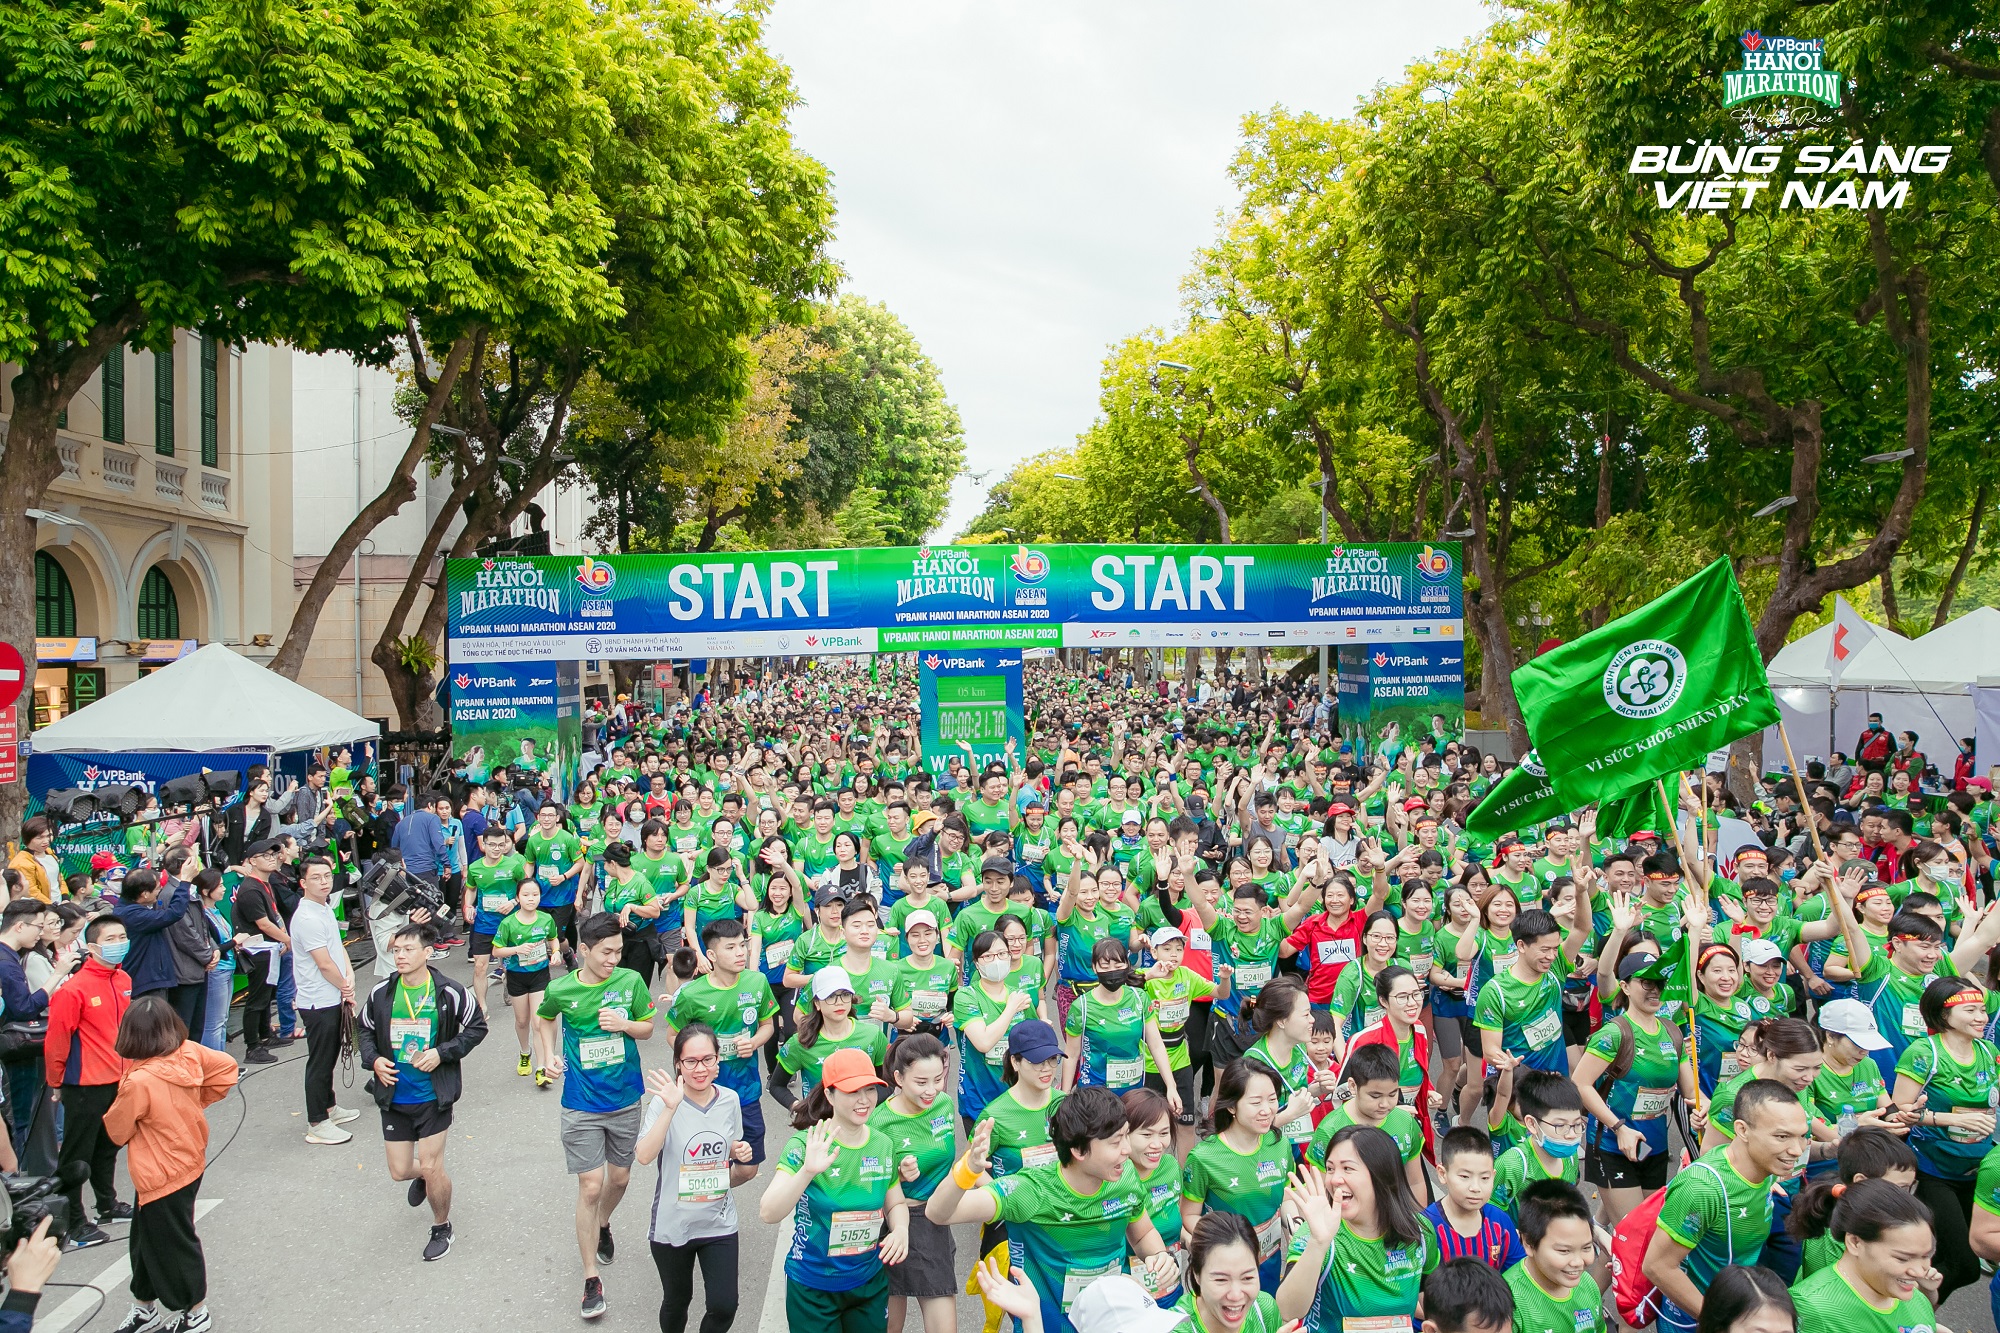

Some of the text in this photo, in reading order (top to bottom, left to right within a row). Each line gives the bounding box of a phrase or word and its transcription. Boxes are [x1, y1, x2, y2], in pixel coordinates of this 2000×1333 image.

[934, 549, 970, 559] VPBank
[1346, 549, 1379, 557] VPBank
[499, 561, 534, 570] VPBank
[912, 558, 979, 576] HANOI
[1326, 557, 1388, 574] HANOI
[476, 570, 544, 588] HANOI
[1091, 555, 1254, 612] START
[668, 561, 838, 621] START
[896, 576, 995, 607] MARATHON
[1015, 588, 1047, 599] ASEAN
[1311, 575, 1402, 603] MARATHON
[1421, 586, 1450, 596] ASEAN
[460, 588, 561, 618] MARATHON
[582, 600, 613, 610] ASEAN
[895, 610, 1050, 622] VPBANK HANOI MARATHON ASEAN 2020
[1309, 605, 1451, 617] VPBANK HANOI MARATHON ASEAN 2020
[460, 621, 617, 634] VPBANK HANOI MARATHON ASEAN 2020
[625, 637, 645, 645] THÀNH
[671, 636, 682, 645] NỘI
[822, 636, 863, 647] VPBank
[883, 628, 1058, 643] VPBANK HANOI MARATHON ASEAN 2020
[644, 645, 652, 653] VÀ
[1664, 646, 1680, 660] MAI
[943, 657, 985, 669] VPBank
[1390, 656, 1428, 666] VPBank
[474, 677, 516, 688] VPBank
[1373, 677, 1400, 685] VPBANK
[1402, 676, 1423, 684] HANOI
[1424, 674, 1462, 682] MARATHON
[958, 687, 986, 697] 05 km
[1374, 686, 1428, 697] ASEAN 2020
[1615, 672, 1684, 717] BACH MAI HOSPITAL
[455, 699, 484, 707] VPBANK
[487, 698, 510, 706] HANOI
[512, 697, 553, 705] MARATHON
[455, 708, 517, 720] ASEAN 2020
[1585, 758, 1604, 773] VÌ
[1604, 746, 1634, 766] SỨC
[1676, 708, 1718, 733] NHÂN
[1717, 690, 1751, 715] DÂN
[103, 770, 145, 781] VPBank
[1535, 786, 1555, 799] KH
[1243, 973, 1264, 982] 52410
[588, 1045, 615, 1059] 50954
[723, 1043, 738, 1053] 513
[688, 1177, 719, 1190] 50430
[841, 1229, 871, 1242] 51575
[1261, 1232, 1273, 1249] 691
